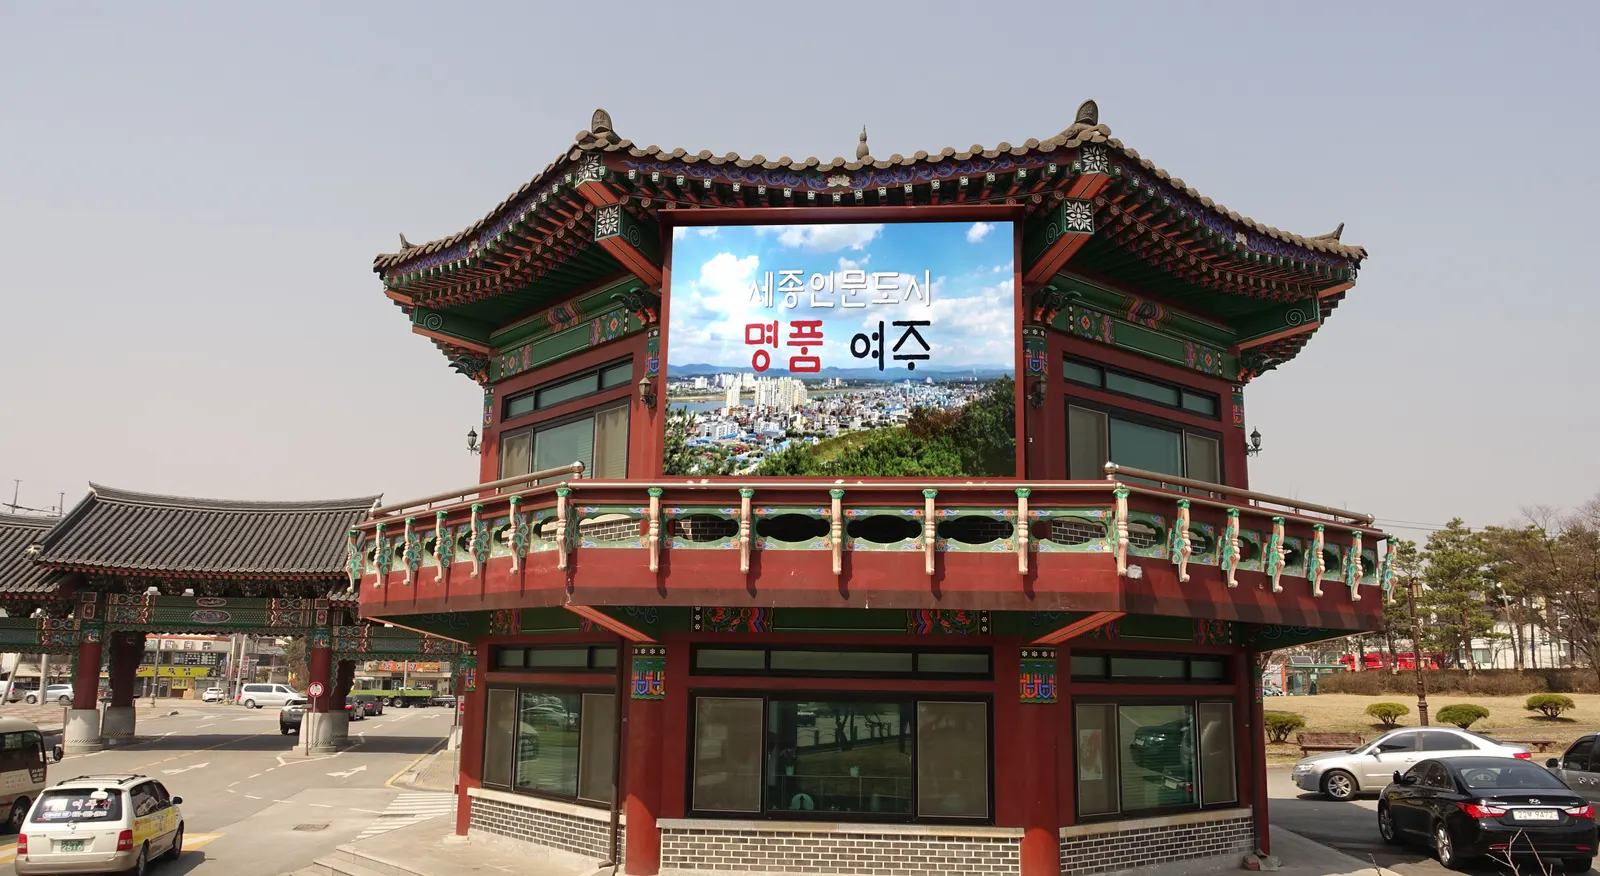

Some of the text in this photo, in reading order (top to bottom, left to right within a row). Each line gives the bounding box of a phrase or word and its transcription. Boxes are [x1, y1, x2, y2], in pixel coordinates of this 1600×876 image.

[748, 269, 931, 309] 세종인문도시
[744, 319, 931, 373] 명품 여주
